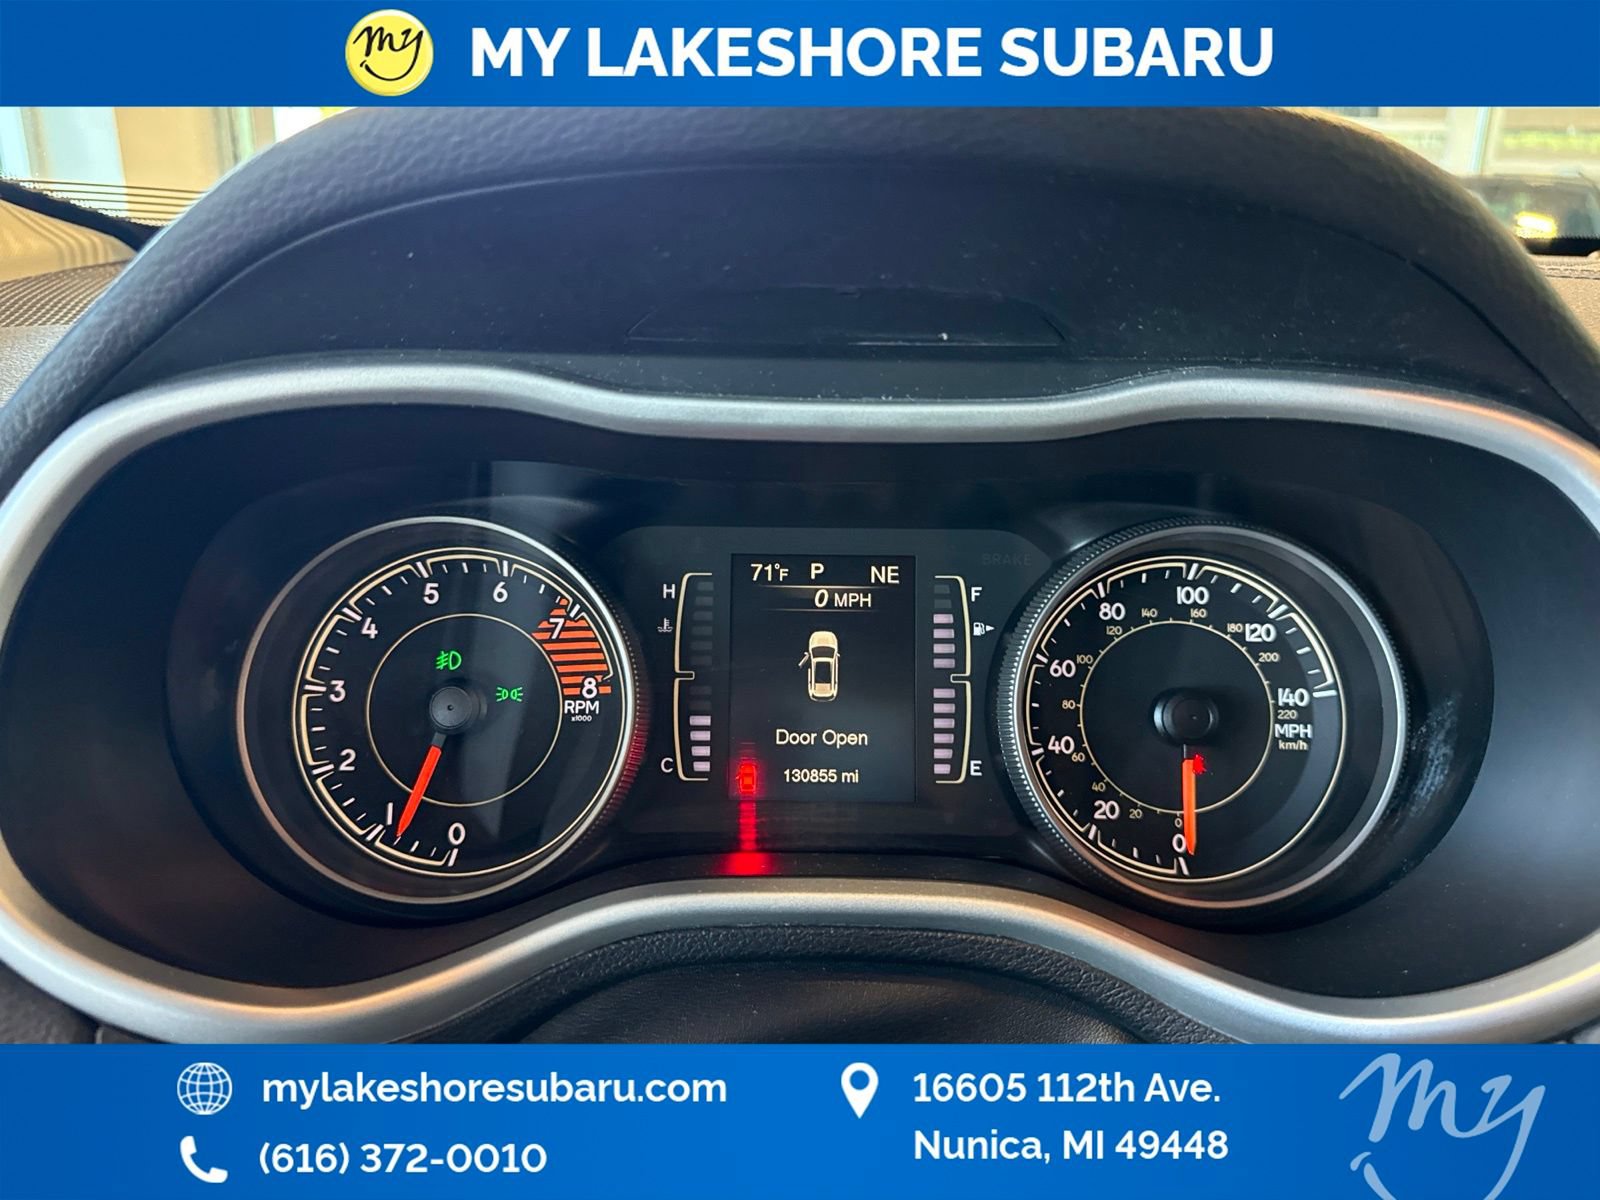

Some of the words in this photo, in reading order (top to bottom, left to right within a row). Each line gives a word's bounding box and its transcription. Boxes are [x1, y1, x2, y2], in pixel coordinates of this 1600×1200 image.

[981, 553, 1032, 567] BRAKE
[810, 563, 825, 580] P
[870, 565, 900, 584] NE
[423, 583, 440, 605] 5
[493, 583, 509, 604] 6
[662, 584, 676, 599] H
[814, 589, 830, 608] 0
[834, 593, 872, 608] MPH
[970, 587, 983, 602] F
[1176, 586, 1209, 606] 100
[1099, 602, 1126, 621] 80
[1141, 608, 1158, 619] 140
[1189, 608, 1207, 619] 160
[361, 617, 379, 640] 4
[548, 618, 565, 640] 7
[1106, 625, 1122, 636] 120
[1227, 623, 1243, 634] 180
[1244, 622, 1277, 643] 120
[1076, 654, 1093, 665] 100
[1258, 652, 1280, 663] 200
[1049, 659, 1076, 678] 60
[329, 681, 346, 703] 3
[581, 678, 598, 700] 8
[1277, 688, 1310, 707] 140
[564, 700, 600, 715] RPM
[1061, 700, 1076, 710] 80
[1277, 710, 1297, 720] 220
[775, 729, 818, 747] Door
[821, 729, 869, 749] Open
[1274, 724, 1313, 740] MPH
[1048, 735, 1075, 755] 40
[1278, 740, 1308, 751] km/h
[339, 749, 357, 772] 2
[660, 757, 674, 774] C
[1071, 752, 1085, 763] 60
[783, 769, 838, 784] 130855
[841, 769, 859, 784] mi
[970, 760, 983, 776] E
[1091, 782, 1106, 792] 40
[385, 802, 394, 826] 1
[1093, 801, 1121, 821] 20
[1129, 808, 1143, 820] 20
[1174, 817, 1183, 828] 0
[448, 823, 466, 846] 0
[1172, 833, 1187, 853] 0
